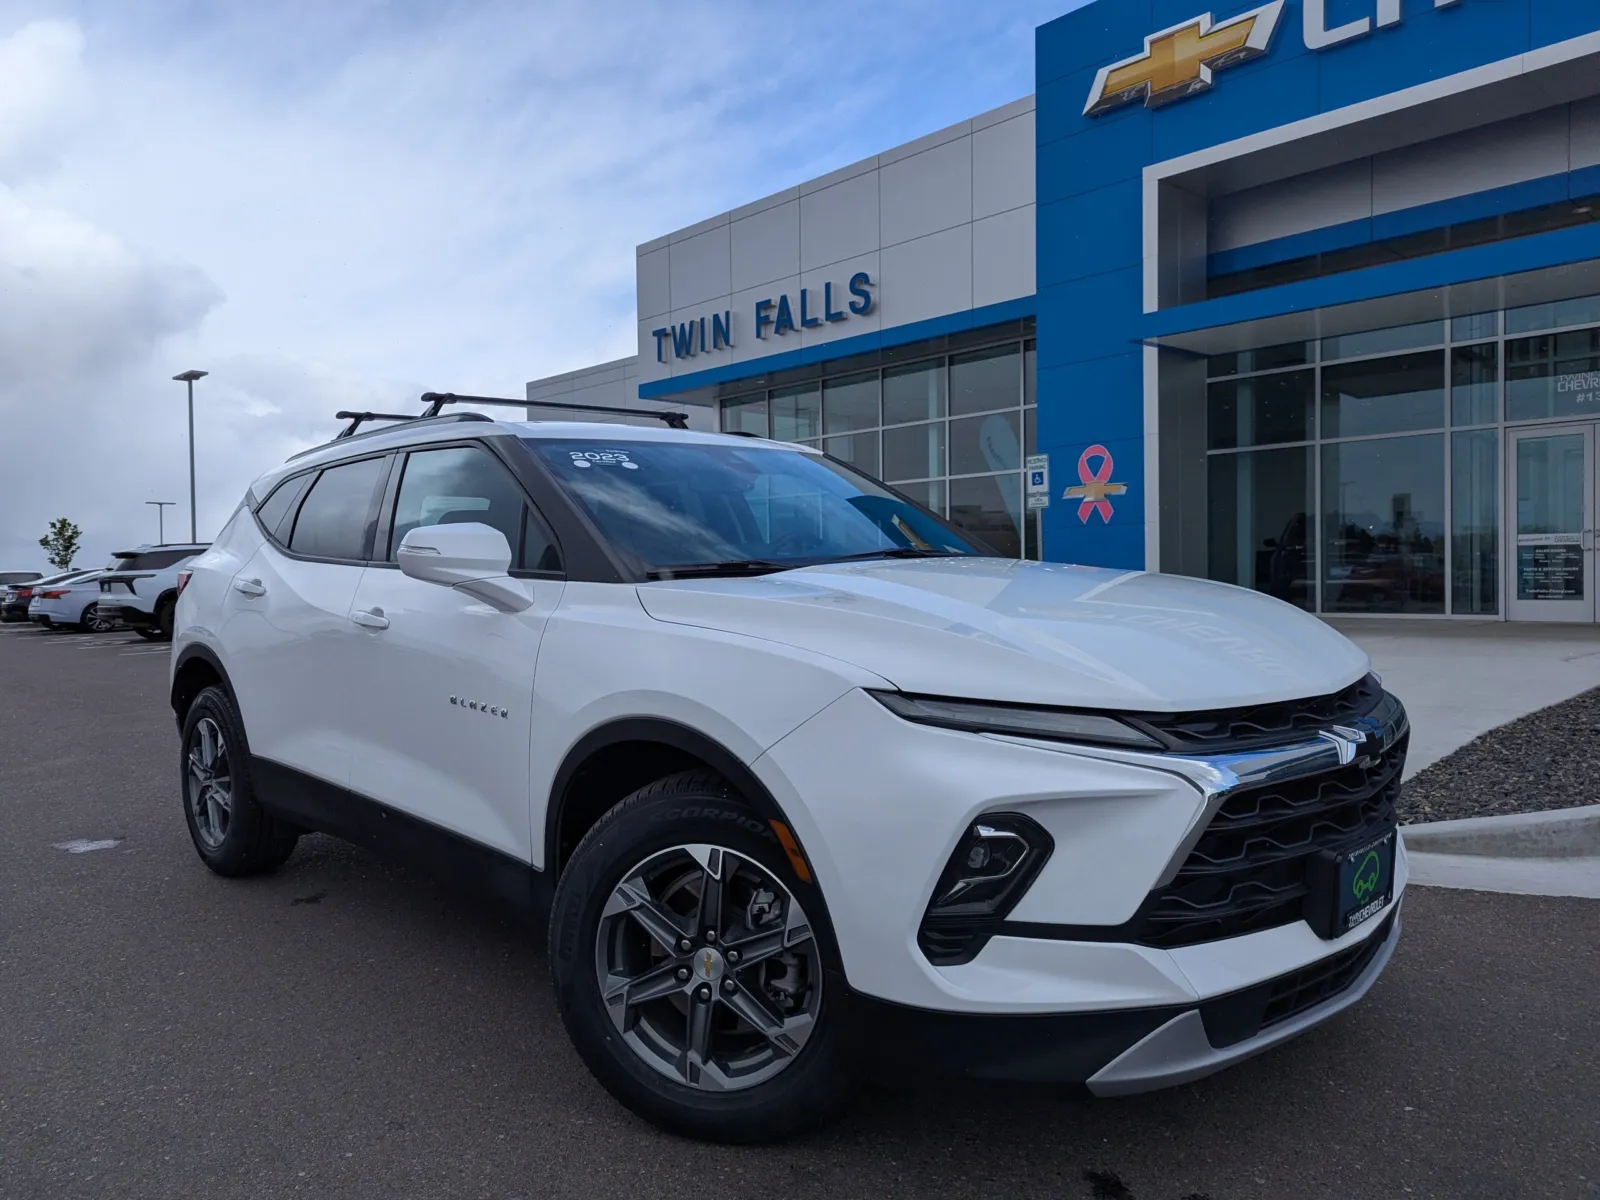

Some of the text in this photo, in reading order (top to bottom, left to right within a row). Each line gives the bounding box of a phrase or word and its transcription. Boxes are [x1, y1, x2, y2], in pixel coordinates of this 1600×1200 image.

[652, 272, 875, 363] TWIN FALLS
[1557, 377, 1600, 393] CHEVR
[569, 451, 630, 462] 2023
[450, 695, 508, 719] BLAZER
